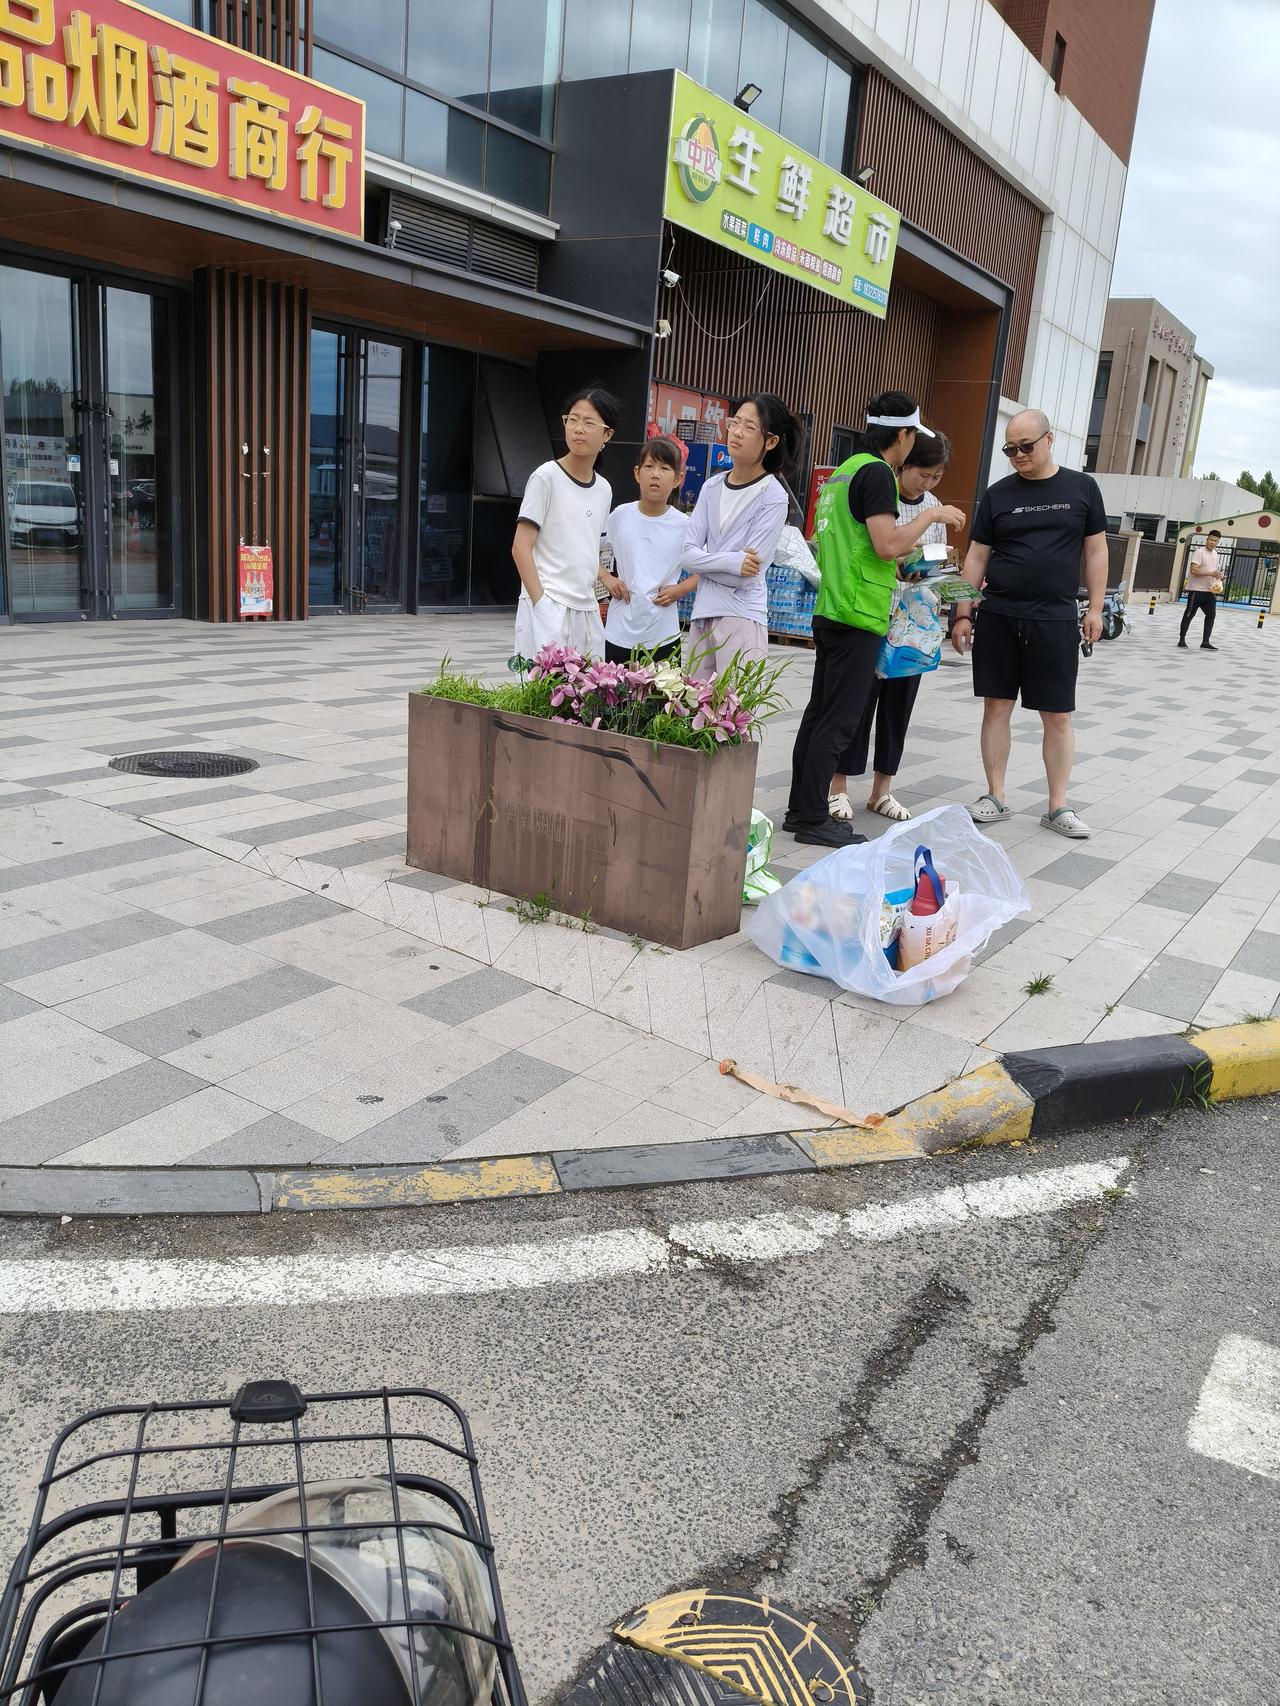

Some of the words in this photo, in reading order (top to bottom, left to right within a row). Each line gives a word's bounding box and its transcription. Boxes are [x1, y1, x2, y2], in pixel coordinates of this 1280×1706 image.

[687, 138, 719, 182] 中区
[725, 125, 893, 265] 生鲜超市
[722, 211, 747, 238] 水果蔬菜
[1024, 503, 1071, 513] SKECHERS
